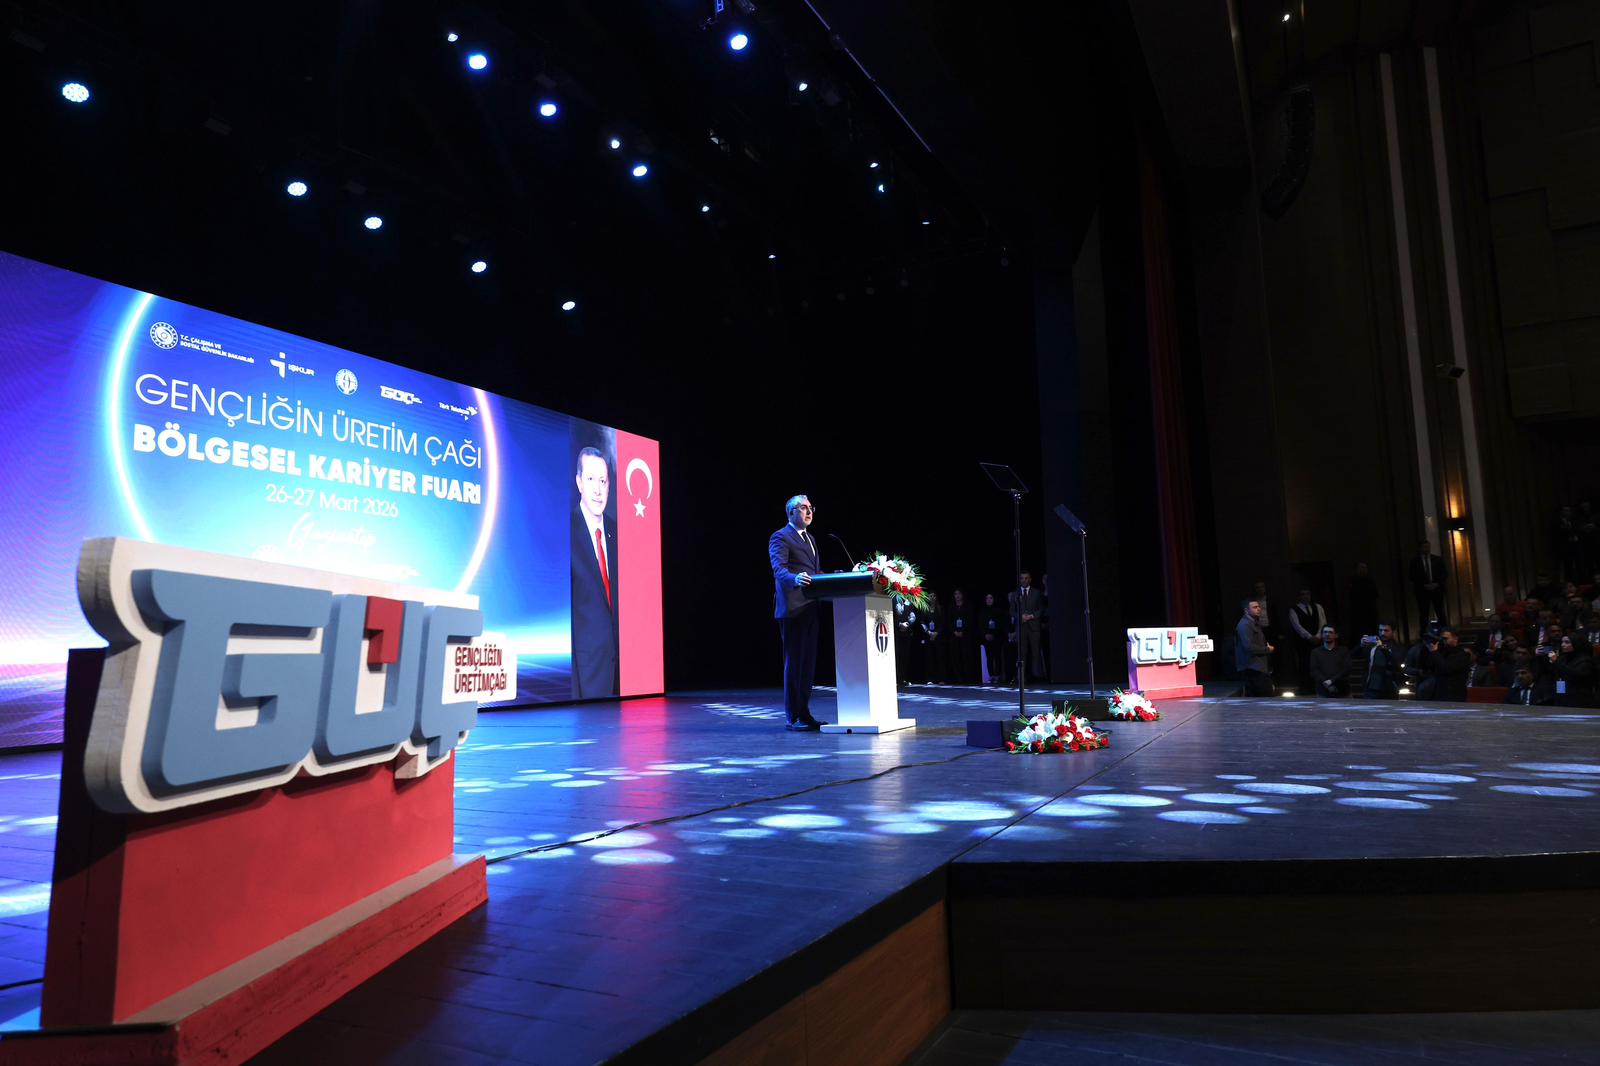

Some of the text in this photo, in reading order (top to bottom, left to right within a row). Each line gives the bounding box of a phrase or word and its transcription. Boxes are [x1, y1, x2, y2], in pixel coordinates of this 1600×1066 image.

[135, 373, 482, 469] GENÇLİĞİN ÜRETİM ÇAĞI
[133, 421, 482, 506] BÖLGESEL KARİYER FUARI
[265, 483, 399, 518] 26-27 Mart 2026
[455, 643, 503, 671] GENÇLİĞİN
